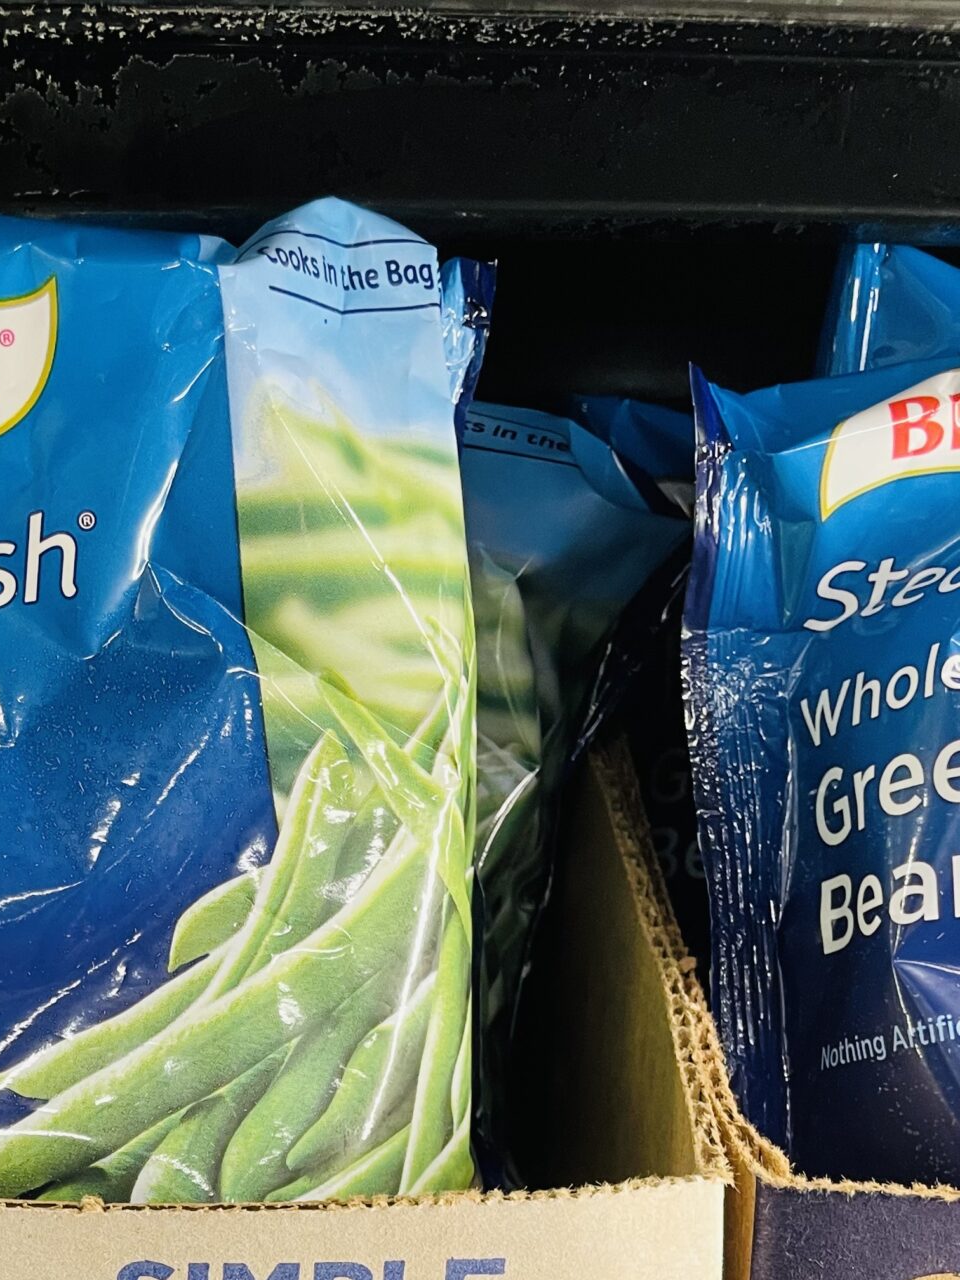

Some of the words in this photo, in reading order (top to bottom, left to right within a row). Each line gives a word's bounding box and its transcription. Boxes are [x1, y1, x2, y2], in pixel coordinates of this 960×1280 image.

[322, 255, 338, 287] in
[340, 265, 380, 291] the
[385, 259, 435, 290] Bag
[491, 419, 518, 441] in
[819, 854, 960, 956] Bea
[820, 1031, 887, 1072] Nothing
